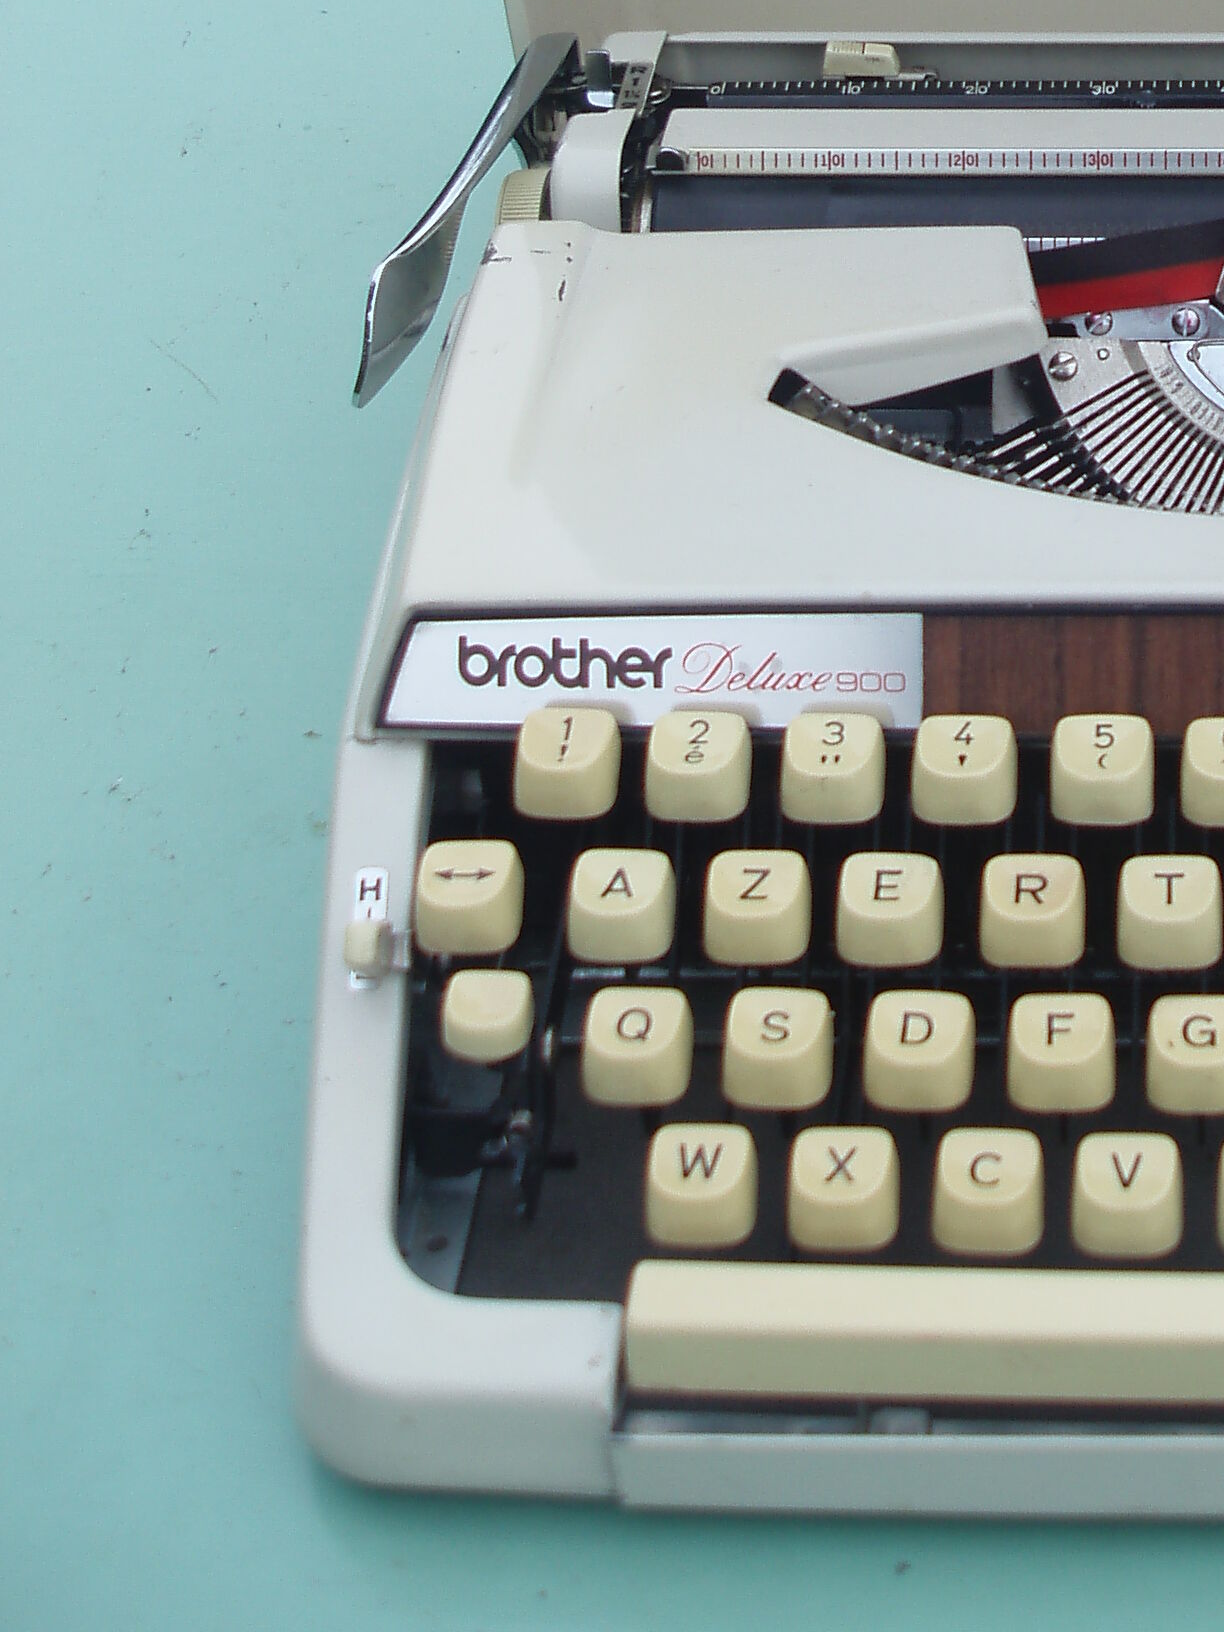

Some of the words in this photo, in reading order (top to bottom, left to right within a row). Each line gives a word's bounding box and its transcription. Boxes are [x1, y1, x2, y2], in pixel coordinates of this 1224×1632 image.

[1091, 84, 1116, 95] 30
[953, 154, 974, 167] 20
[1088, 153, 1109, 167] 30
[457, 635, 673, 689] brother
[674, 641, 835, 694] Deluxe
[836, 671, 907, 692] 900
[563, 716, 573, 741] 1
[689, 720, 710, 744] 2
[822, 721, 845, 745] 3
[954, 722, 974, 745] 4
[1094, 724, 1114, 748] 5
[359, 877, 382, 901] H
[601, 867, 635, 898] A
[739, 869, 772, 899] Z
[873, 869, 903, 900] E
[1014, 874, 1048, 904] R
[1154, 873, 1184, 905] T
[616, 1008, 652, 1040] Q
[762, 1010, 791, 1042] S
[900, 1010, 933, 1045] D
[1046, 1013, 1075, 1046] F
[1182, 1015, 1217, 1048] G
[679, 1143, 723, 1179] W
[824, 1146, 858, 1182] X
[969, 1152, 1003, 1186] C
[1111, 1153, 1143, 1187] V
